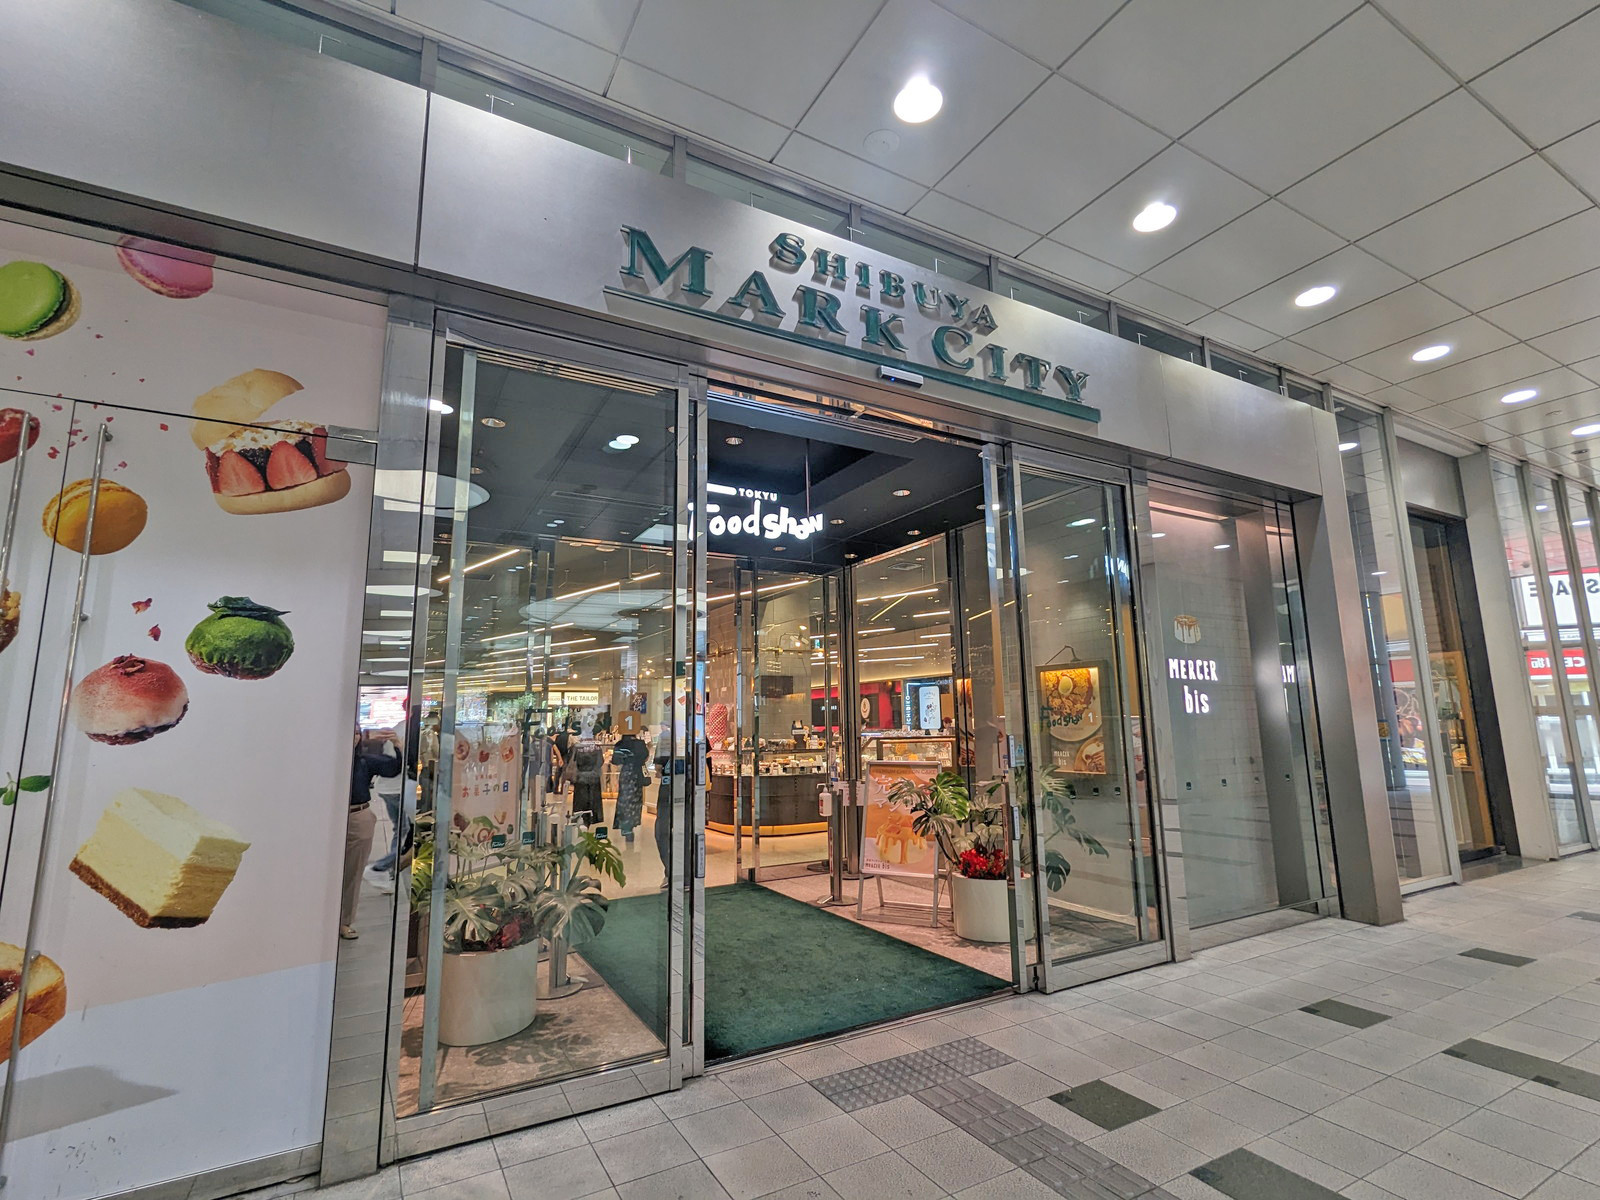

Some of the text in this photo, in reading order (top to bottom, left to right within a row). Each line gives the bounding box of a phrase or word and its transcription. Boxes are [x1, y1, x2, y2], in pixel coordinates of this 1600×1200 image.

[773, 232, 998, 330] SHIBUYA
[619, 224, 1090, 402] MARK CITY
[738, 487, 777, 502] TOKYU
[1168, 658, 1218, 681] MERCER
[1184, 685, 1209, 713] bis
[624, 715, 633, 730] 1
